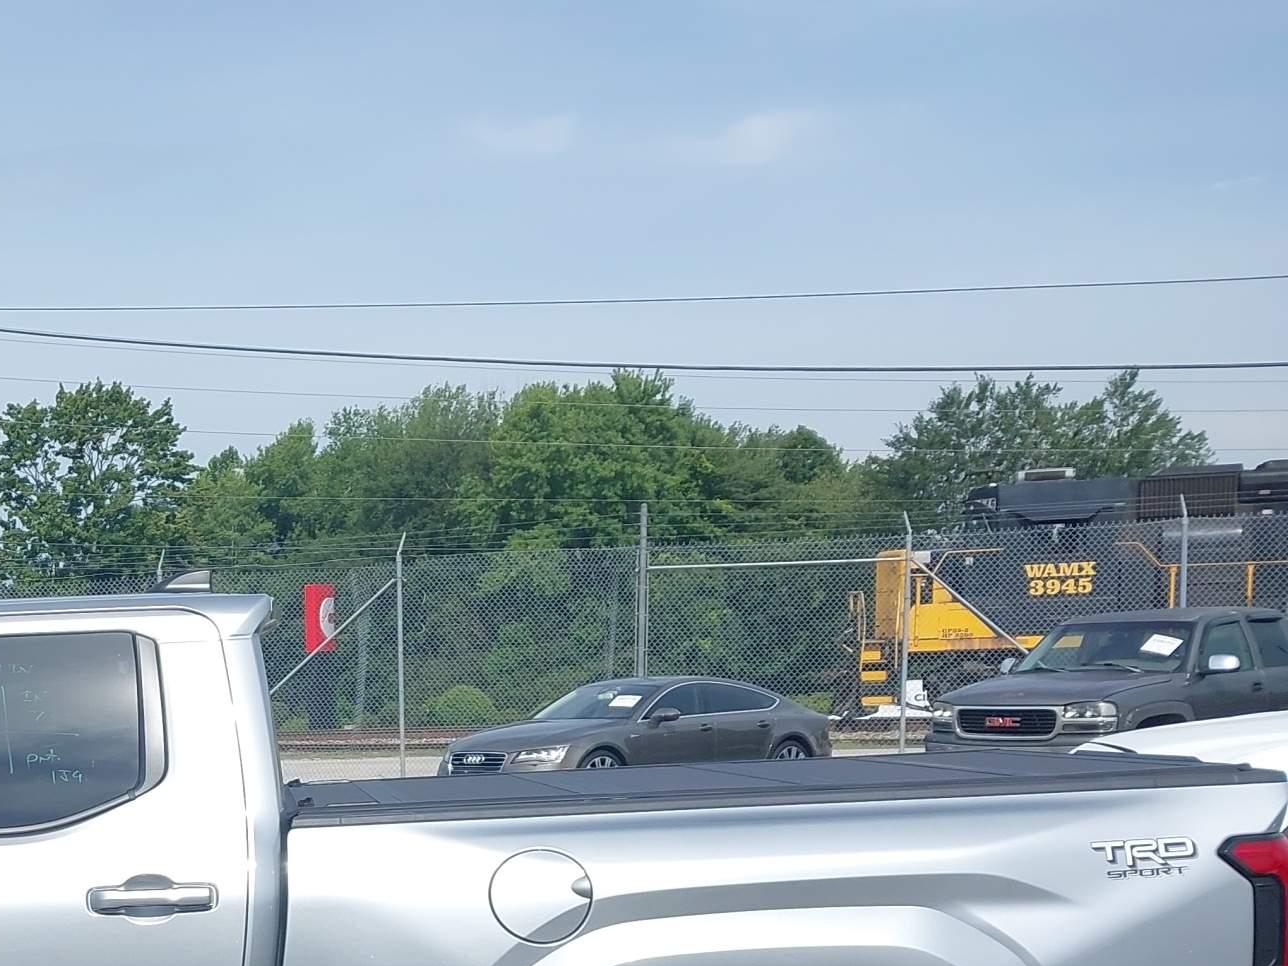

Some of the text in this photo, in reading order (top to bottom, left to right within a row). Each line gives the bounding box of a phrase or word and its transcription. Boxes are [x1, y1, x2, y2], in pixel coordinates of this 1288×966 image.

[1024, 561, 1097, 578] WAMX
[1029, 577, 1093, 595] 3945
[985, 716, 1022, 727] GMC
[1090, 836, 1198, 868] TRD
[1107, 866, 1188, 879] SPORT
